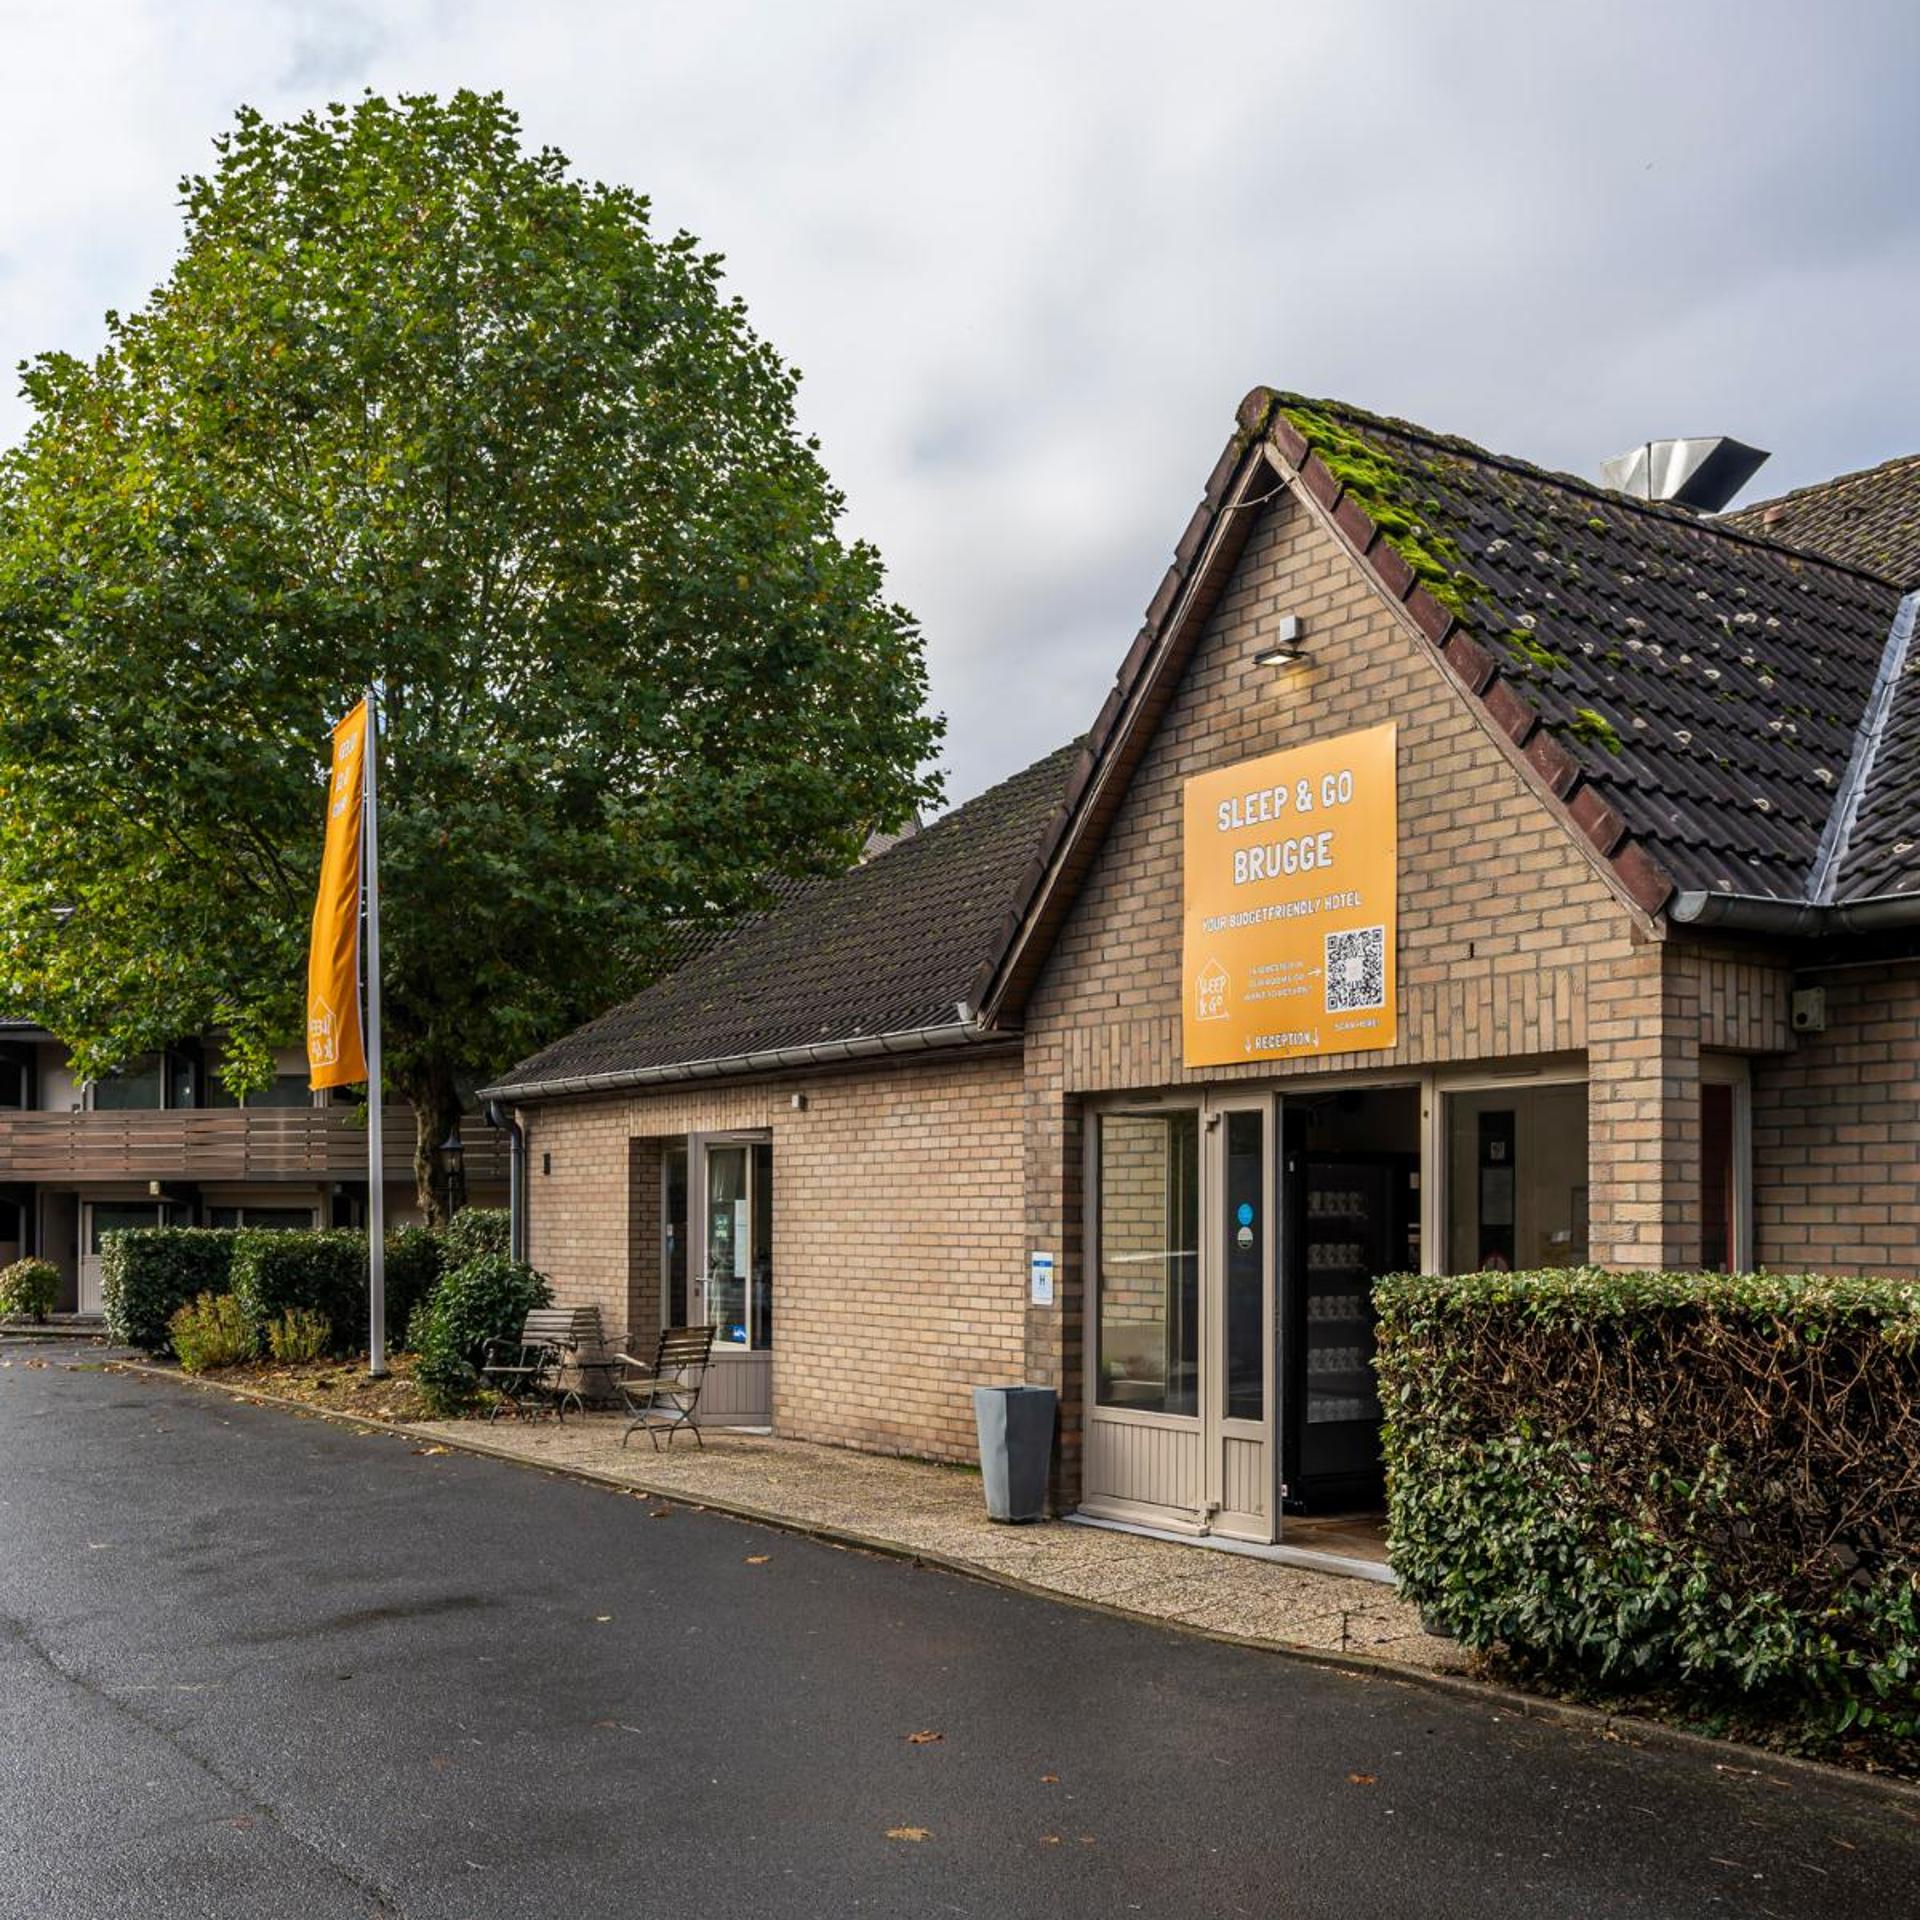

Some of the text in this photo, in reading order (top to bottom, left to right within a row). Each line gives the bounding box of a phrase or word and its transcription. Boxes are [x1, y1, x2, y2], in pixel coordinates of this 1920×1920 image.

[1218, 769, 1353, 831] SLEEP & GO
[1234, 831, 1333, 885] BRUGGE
[1202, 890, 1362, 932] YOUR BUDGETFRIENDLY HOTEL
[1255, 1032, 1311, 1049] RECEPTION
